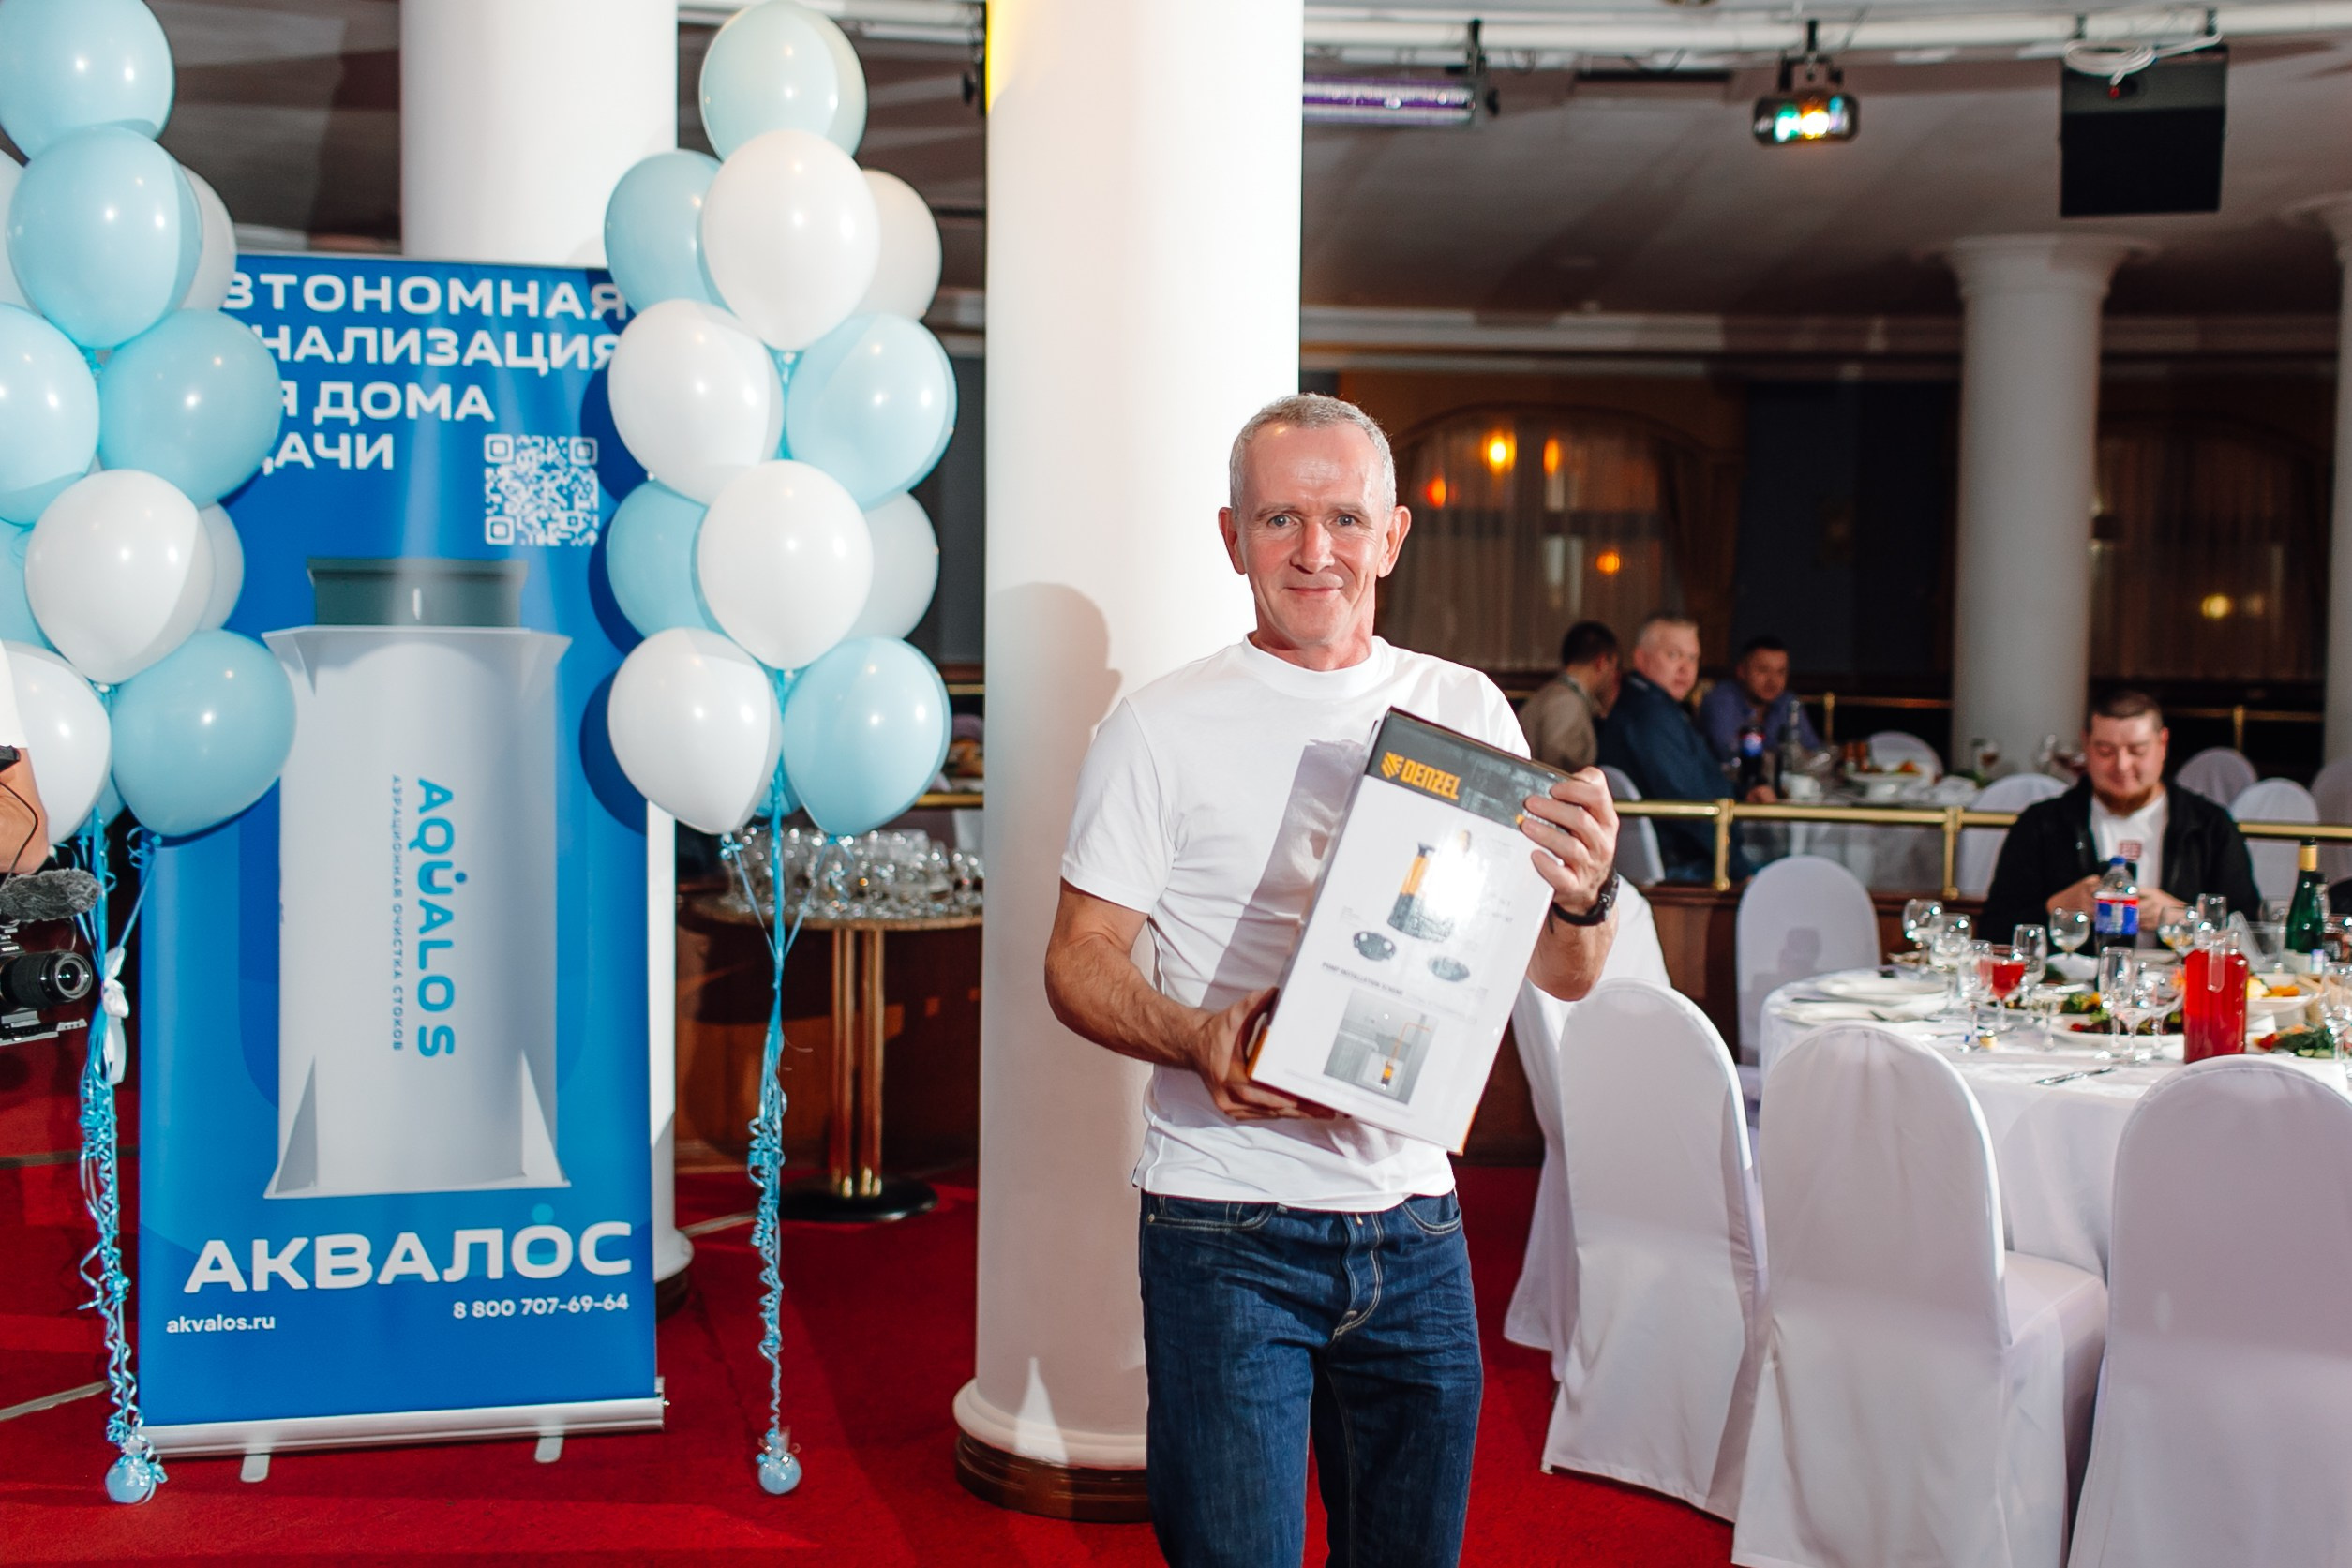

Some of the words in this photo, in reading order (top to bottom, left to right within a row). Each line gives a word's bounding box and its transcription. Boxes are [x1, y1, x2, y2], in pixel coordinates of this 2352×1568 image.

[313, 381, 496, 427] ДОМА
[262, 431, 394, 476] АЧИ
[1399, 759, 1462, 801] DENZEL
[392, 903, 403, 979] ОЧИСТКА
[392, 985, 403, 1052] СТОКОВ
[184, 1221, 633, 1293] АКВАЛОС
[166, 1313, 276, 1334] akvalos.ru
[453, 1301, 467, 1319] 8
[472, 1299, 516, 1318] 800
[520, 1292, 630, 1316] 707-69-64
